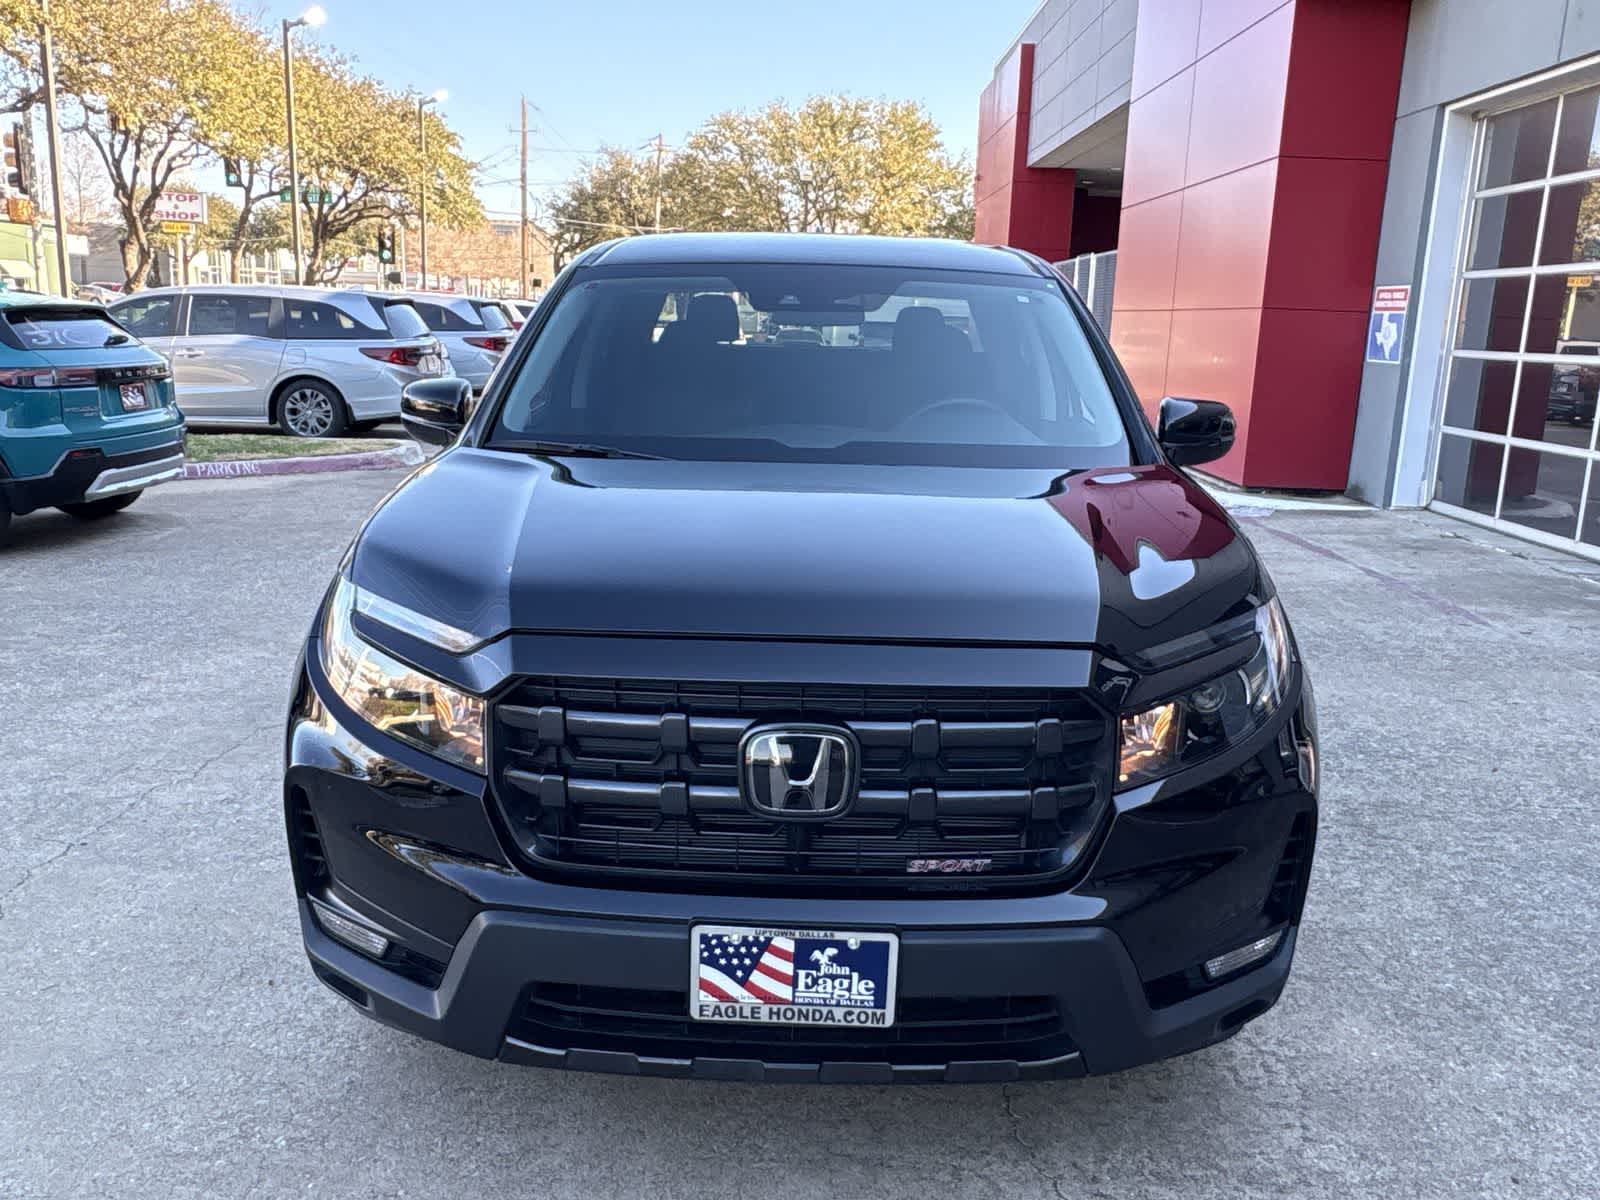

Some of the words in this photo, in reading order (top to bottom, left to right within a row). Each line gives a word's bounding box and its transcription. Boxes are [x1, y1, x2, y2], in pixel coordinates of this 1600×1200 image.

[155, 210, 201, 220] SHOP
[196, 461, 261, 478] PARKING
[906, 859, 992, 873] SPORT
[754, 928, 796, 938] UPTOWN
[799, 930, 835, 939] DALLAS
[817, 962, 850, 977] John
[794, 968, 876, 1000] Eagle
[794, 995, 825, 1005] HONDA
[826, 998, 838, 1006] OF
[839, 999, 875, 1008] DALLAS
[699, 1003, 762, 1020] EAGLE
[768, 1006, 887, 1025] HONDA.COM
